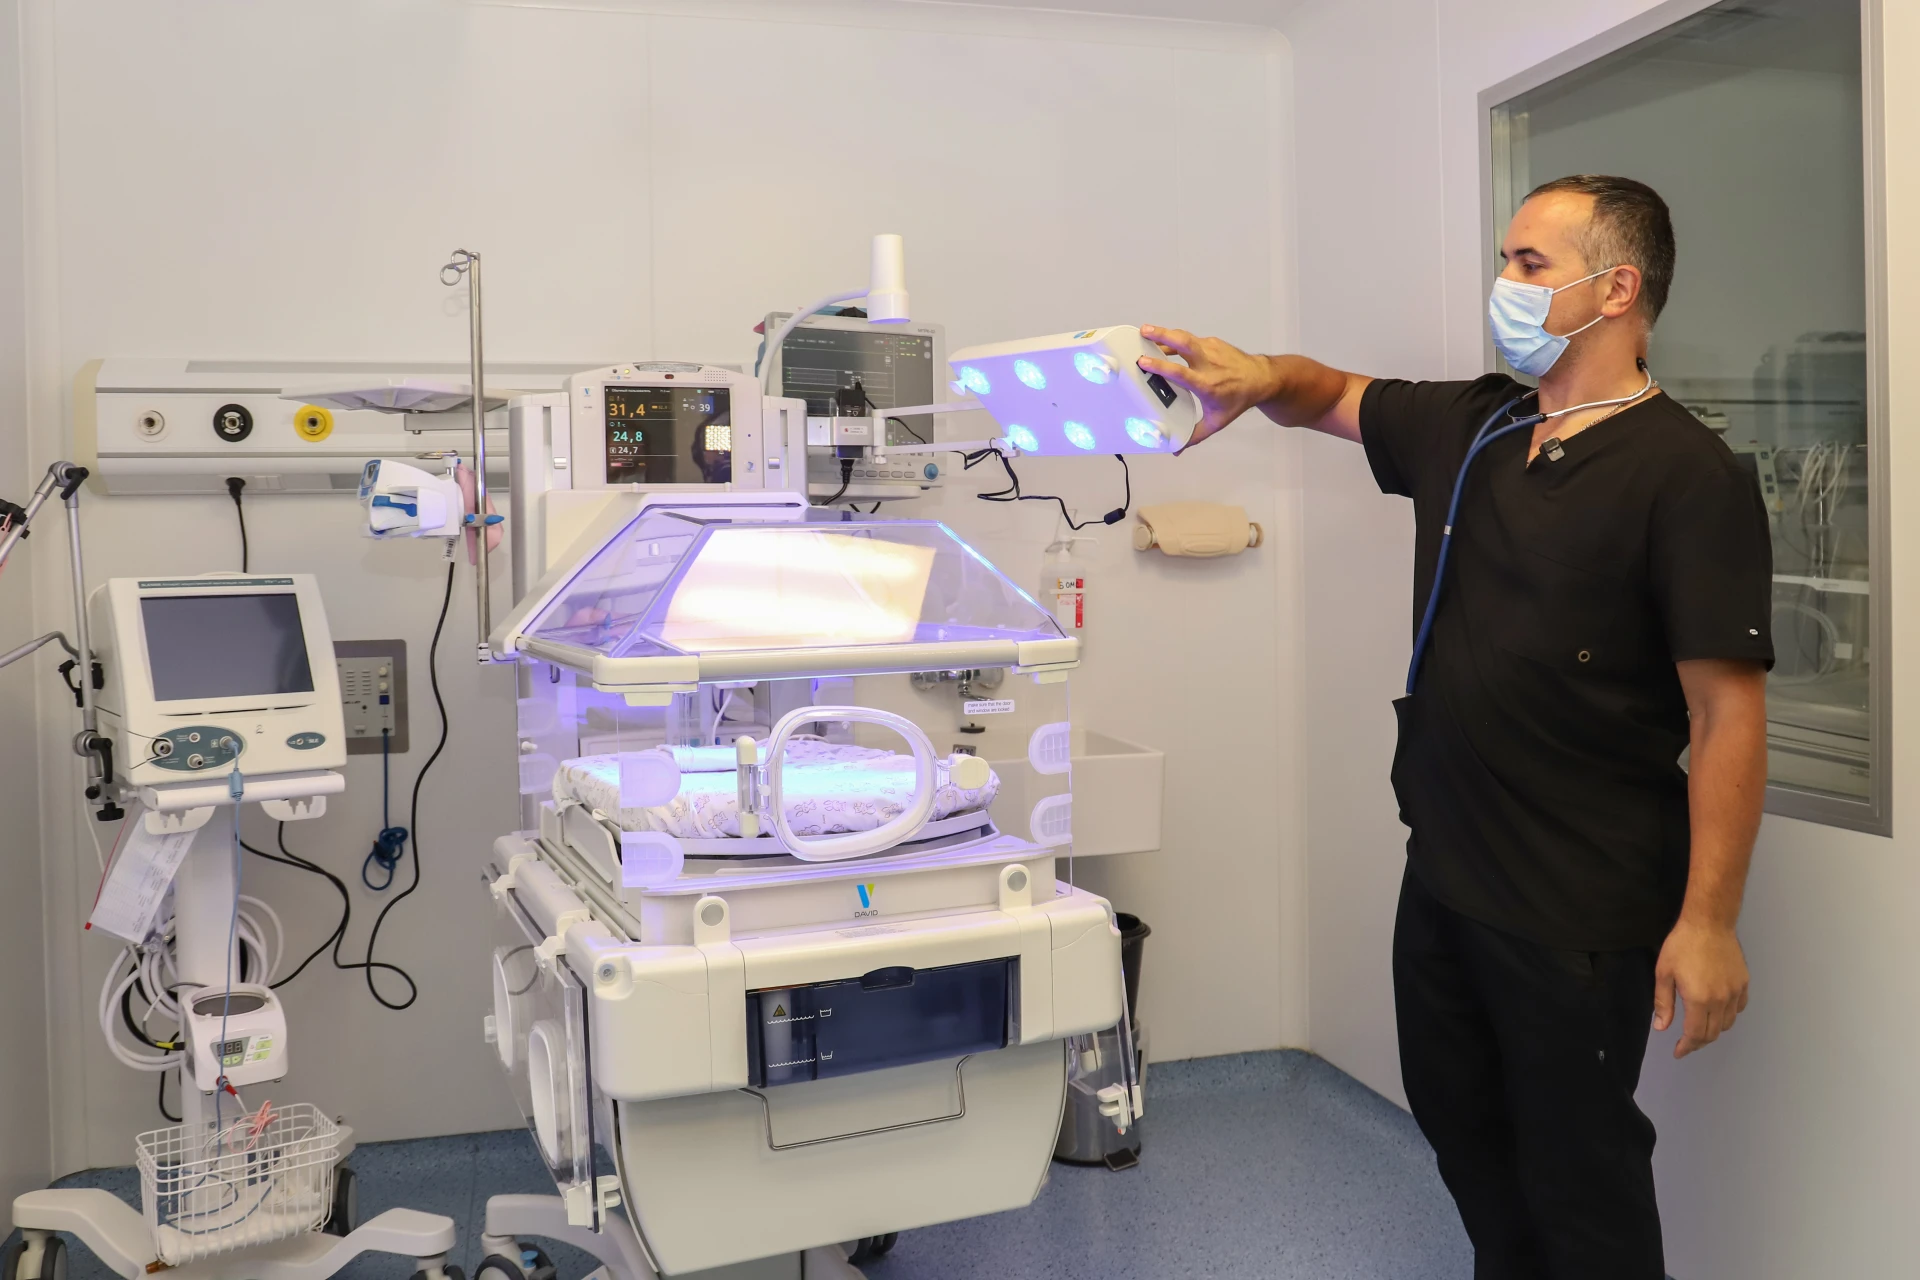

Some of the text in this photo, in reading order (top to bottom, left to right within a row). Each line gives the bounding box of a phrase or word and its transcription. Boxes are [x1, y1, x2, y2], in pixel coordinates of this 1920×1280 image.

[609, 403, 645, 418] 31,4
[699, 403, 711, 412] 39
[613, 431, 643, 443] 24,8
[618, 446, 638, 454] 24,7
[255, 724, 264, 734] 2
[854, 910, 878, 918] DAVID
